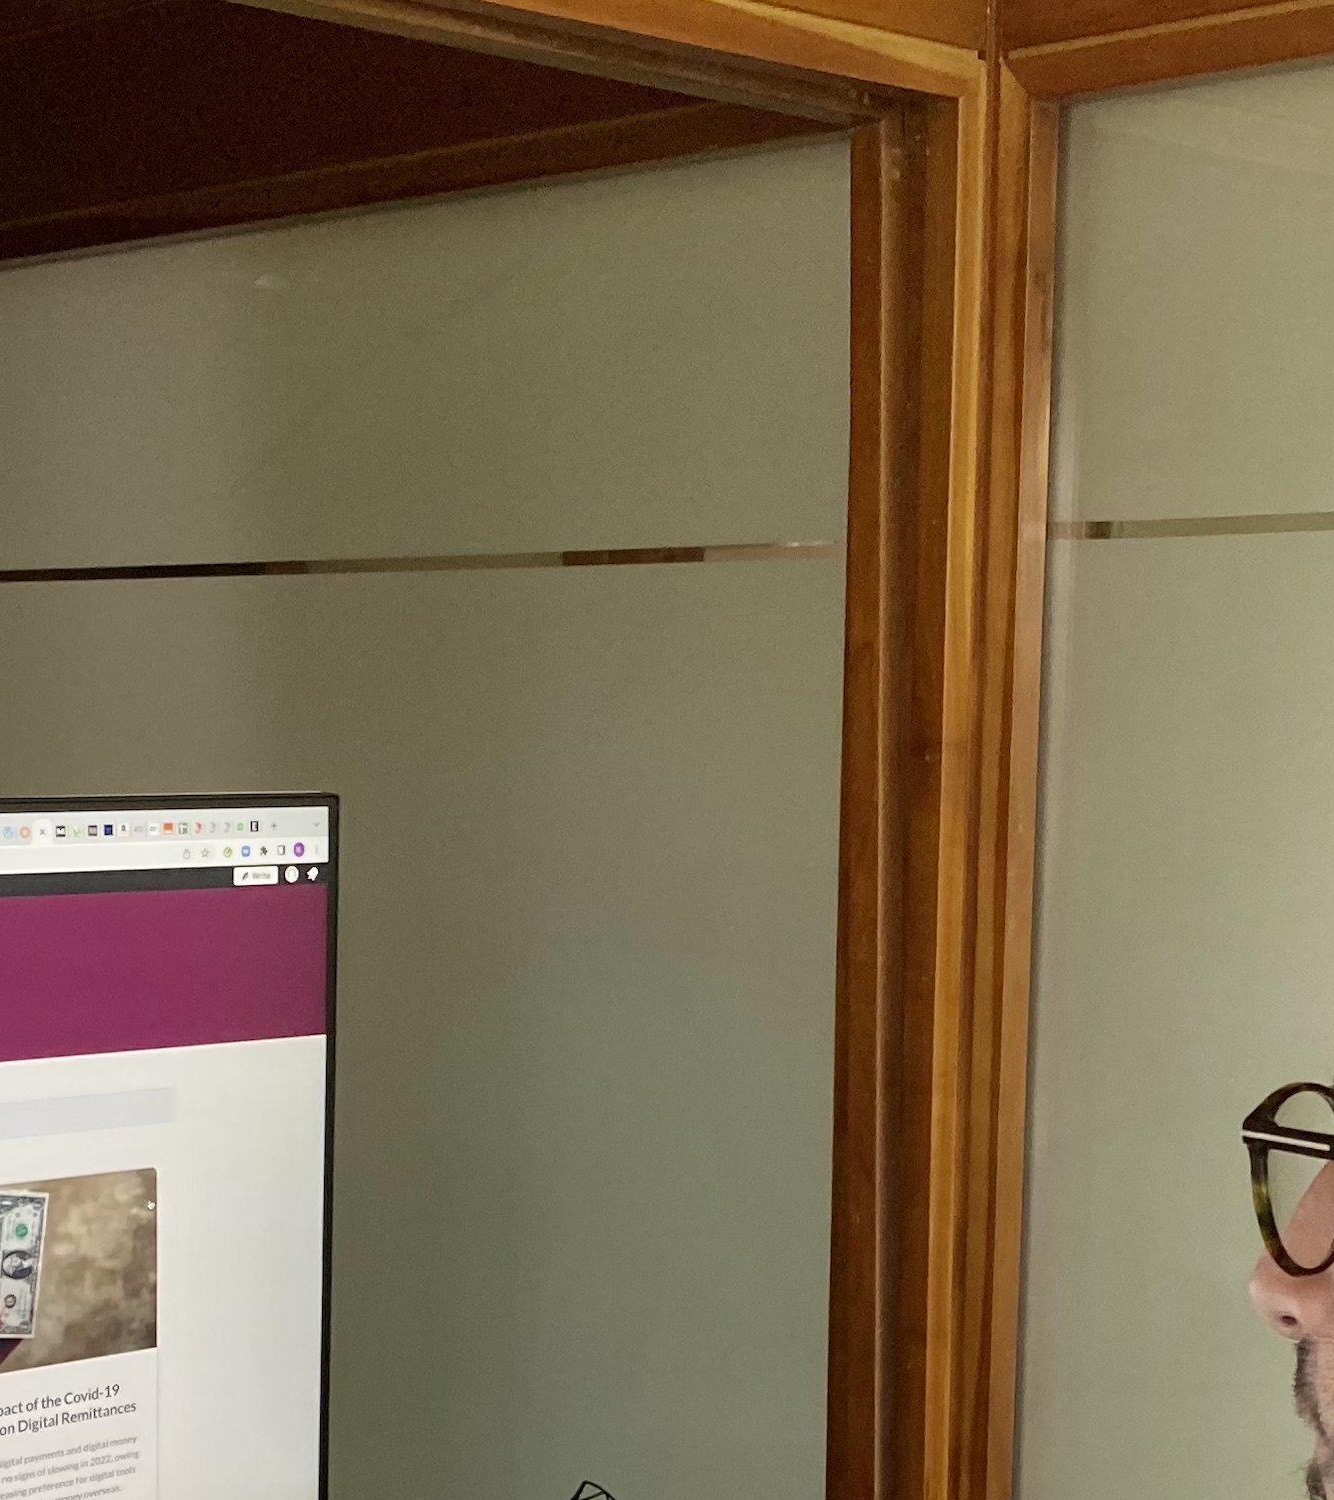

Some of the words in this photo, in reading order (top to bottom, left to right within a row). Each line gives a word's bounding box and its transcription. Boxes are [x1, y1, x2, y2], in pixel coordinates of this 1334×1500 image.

[26, 1398, 38, 1411] of
[41, 1397, 61, 1408] the
[64, 1385, 119, 1404] Covid-19
[0, 1426, 14, 1435] on
[18, 1415, 58, 1432] Digital
[61, 1404, 136, 1423] Remittances
[24, 1451, 64, 1464] payments
[66, 1446, 81, 1455] and
[83, 1441, 108, 1452] digital
[110, 1438, 137, 1446] money
[83, 1487, 121, 1497] overseas.
